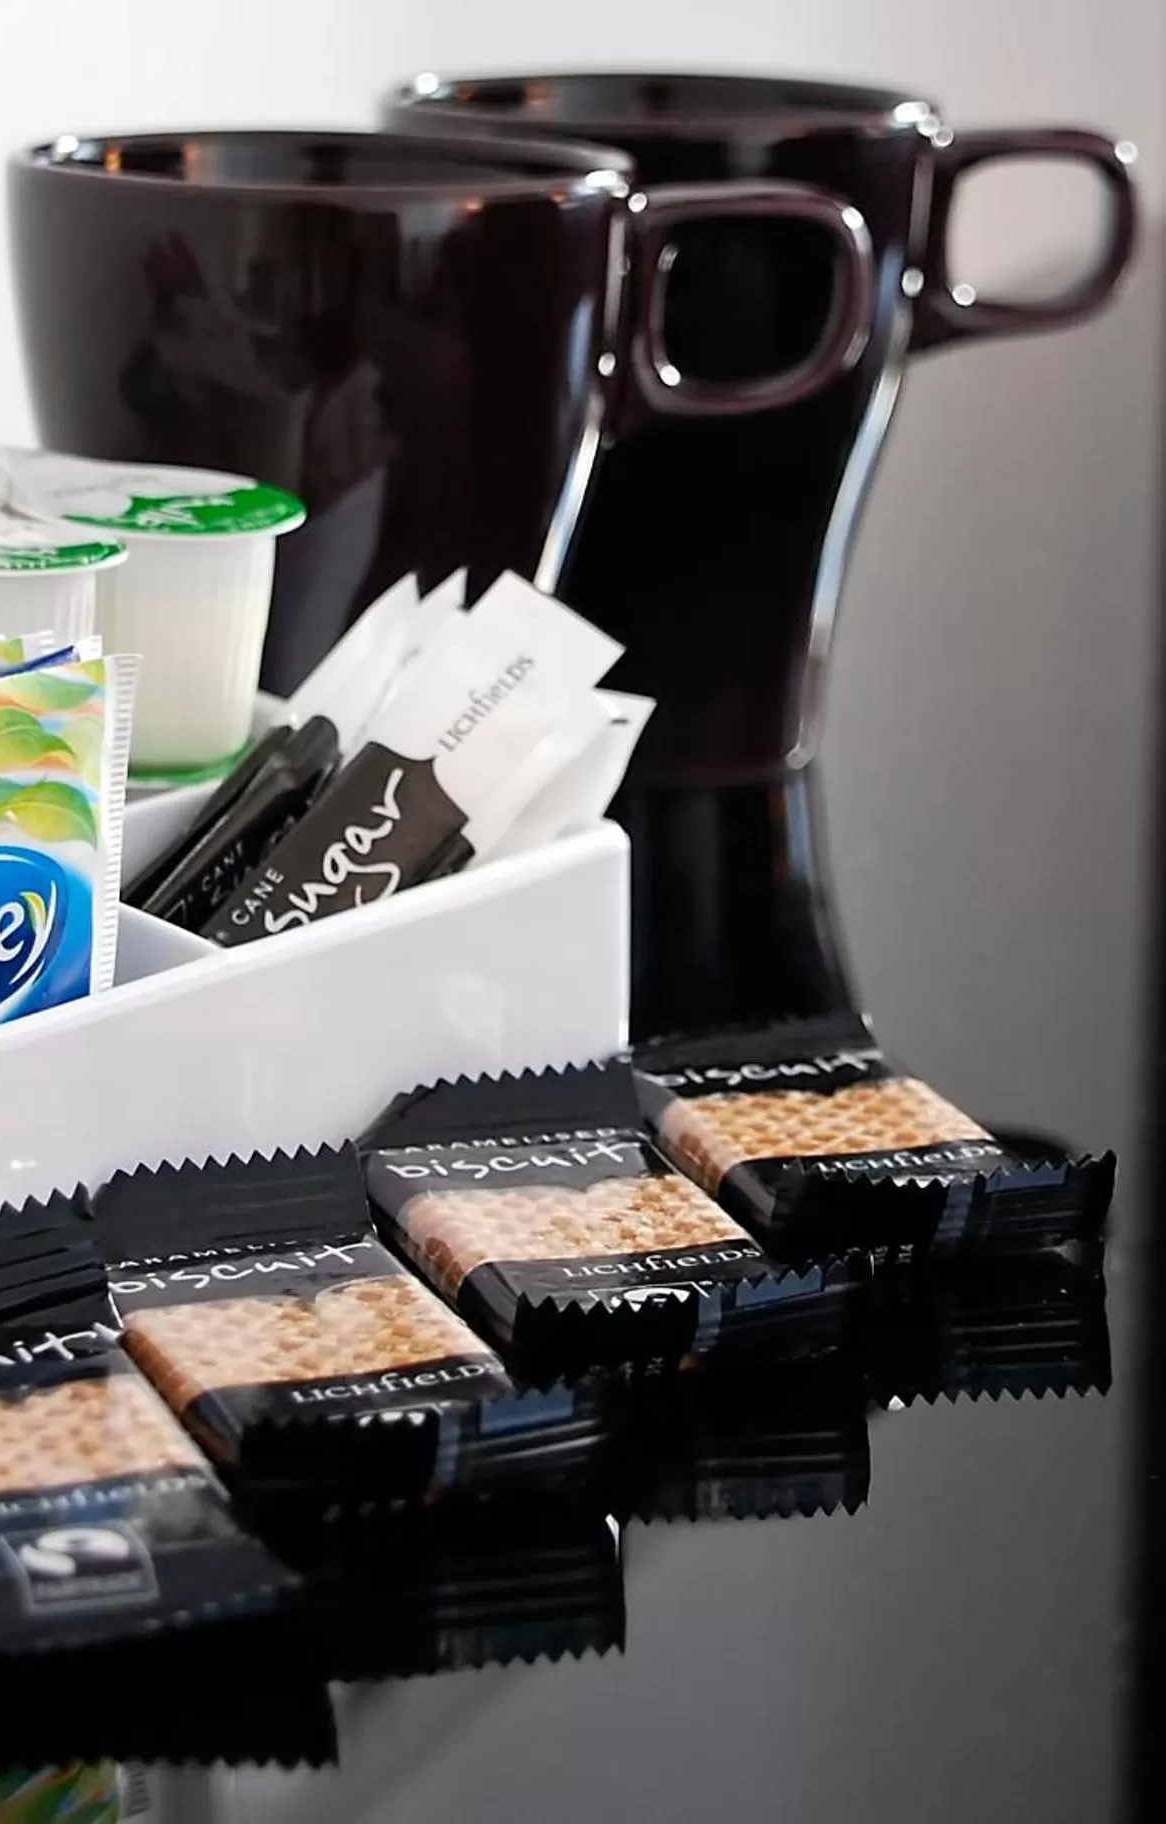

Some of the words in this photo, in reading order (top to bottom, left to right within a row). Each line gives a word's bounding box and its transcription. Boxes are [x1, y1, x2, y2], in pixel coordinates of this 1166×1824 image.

[264, 767, 405, 933] sugar
[231, 867, 285, 926] CANE
[630, 1050, 884, 1088] biscuit
[385, 1139, 641, 1179] biscuit
[107, 1243, 373, 1290] biscuit
